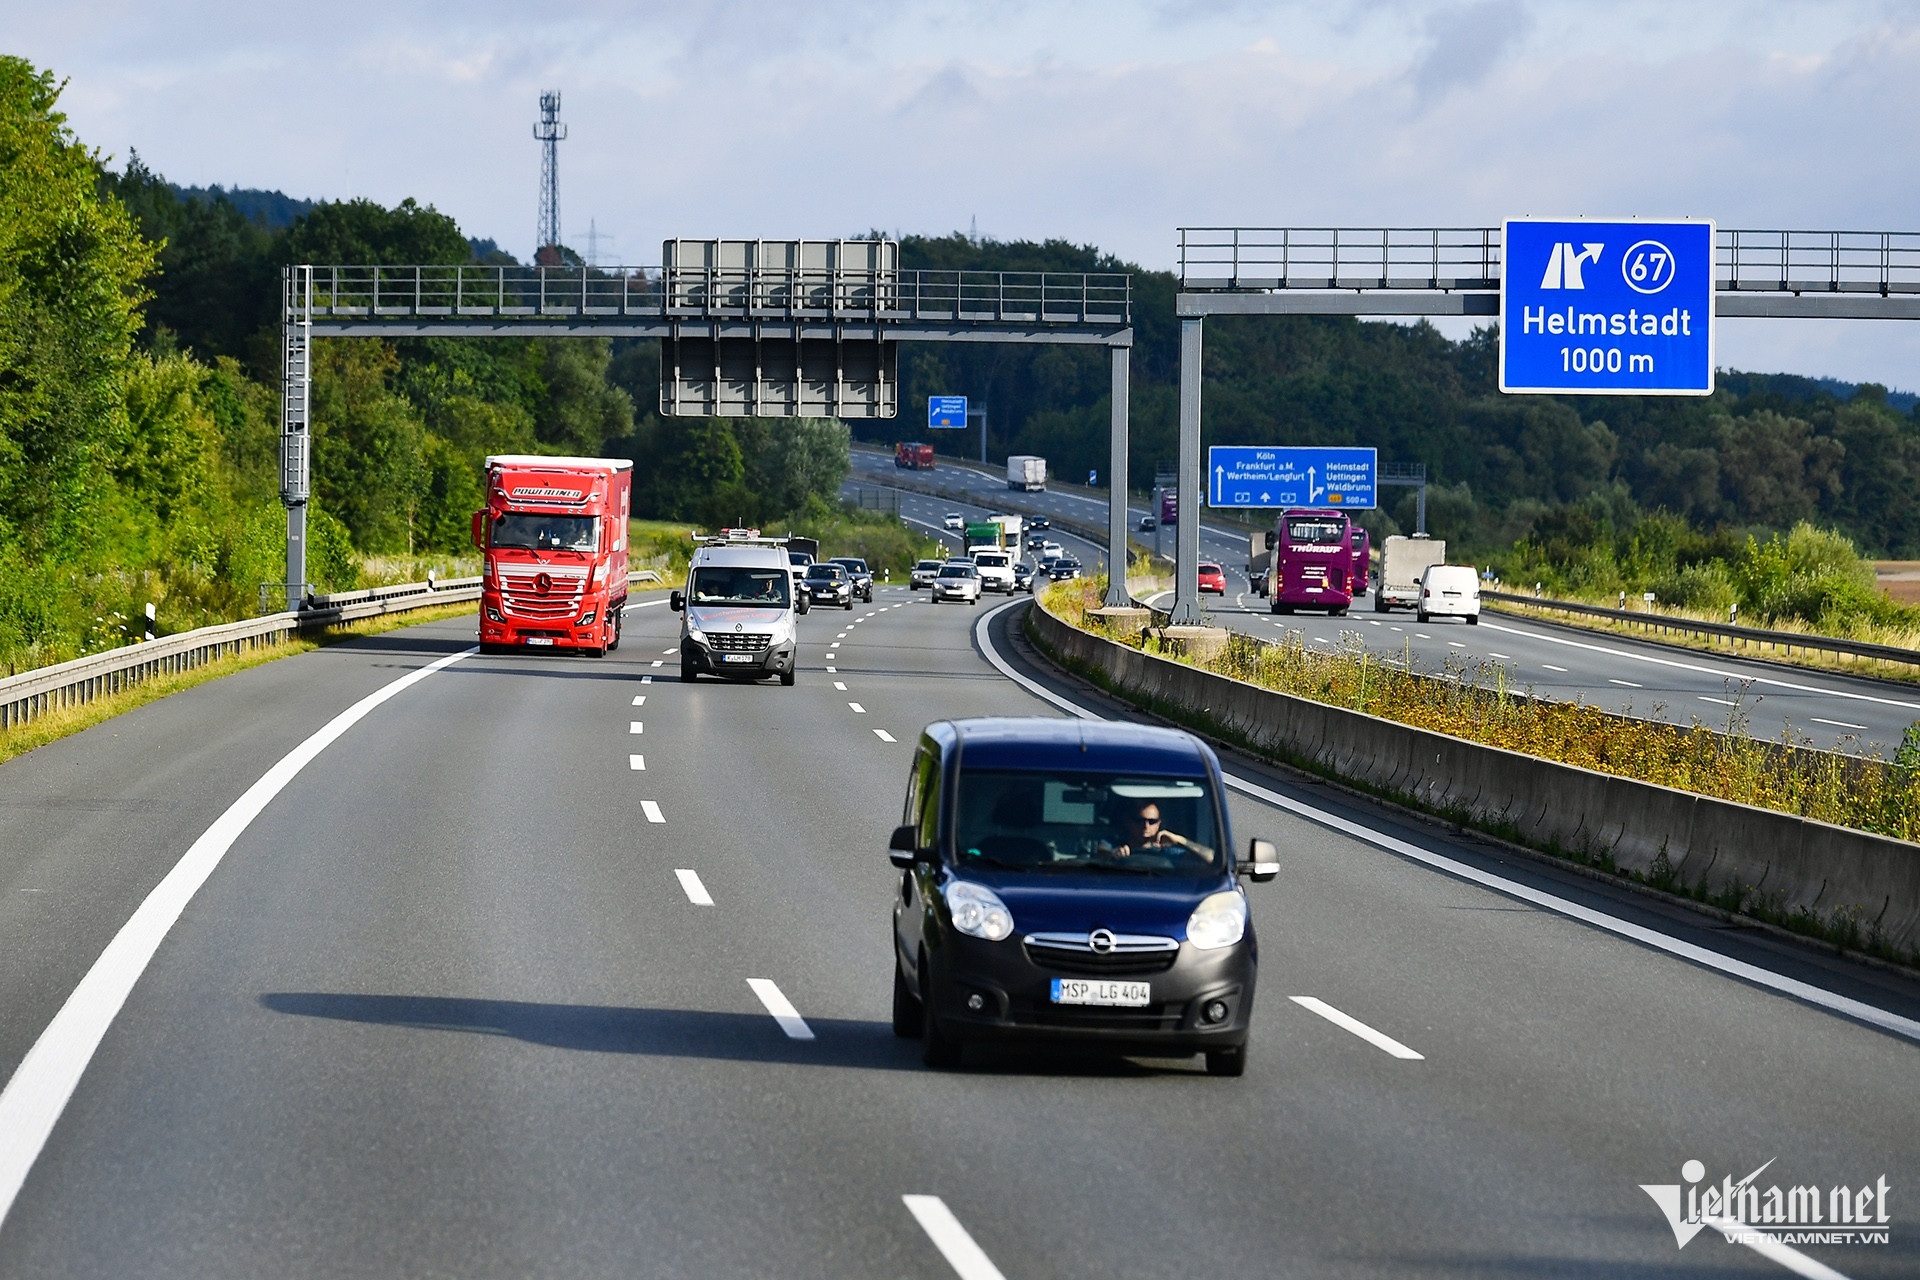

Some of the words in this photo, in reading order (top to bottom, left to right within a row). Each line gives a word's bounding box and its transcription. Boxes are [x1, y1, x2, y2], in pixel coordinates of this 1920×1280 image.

[1630, 253, 1667, 281] 67
[1523, 305, 1691, 335] Helmstadt
[1560, 347, 1622, 373] 1000
[1629, 353, 1654, 373] m
[1256, 452, 1276, 460] Köln
[1236, 461, 1275, 470] Frankfurt
[1326, 463, 1369, 471] Helmstadt
[1227, 472, 1305, 481] Wertheim/Lengfurt
[1326, 473, 1366, 482] Uettingen
[1326, 483, 1371, 491] Waldbrunn
[1288, 543, 1343, 553] THÜRAUF
[1061, 983, 1089, 998] MSP
[1100, 985, 1118, 999] LG
[1122, 986, 1147, 999] 404
